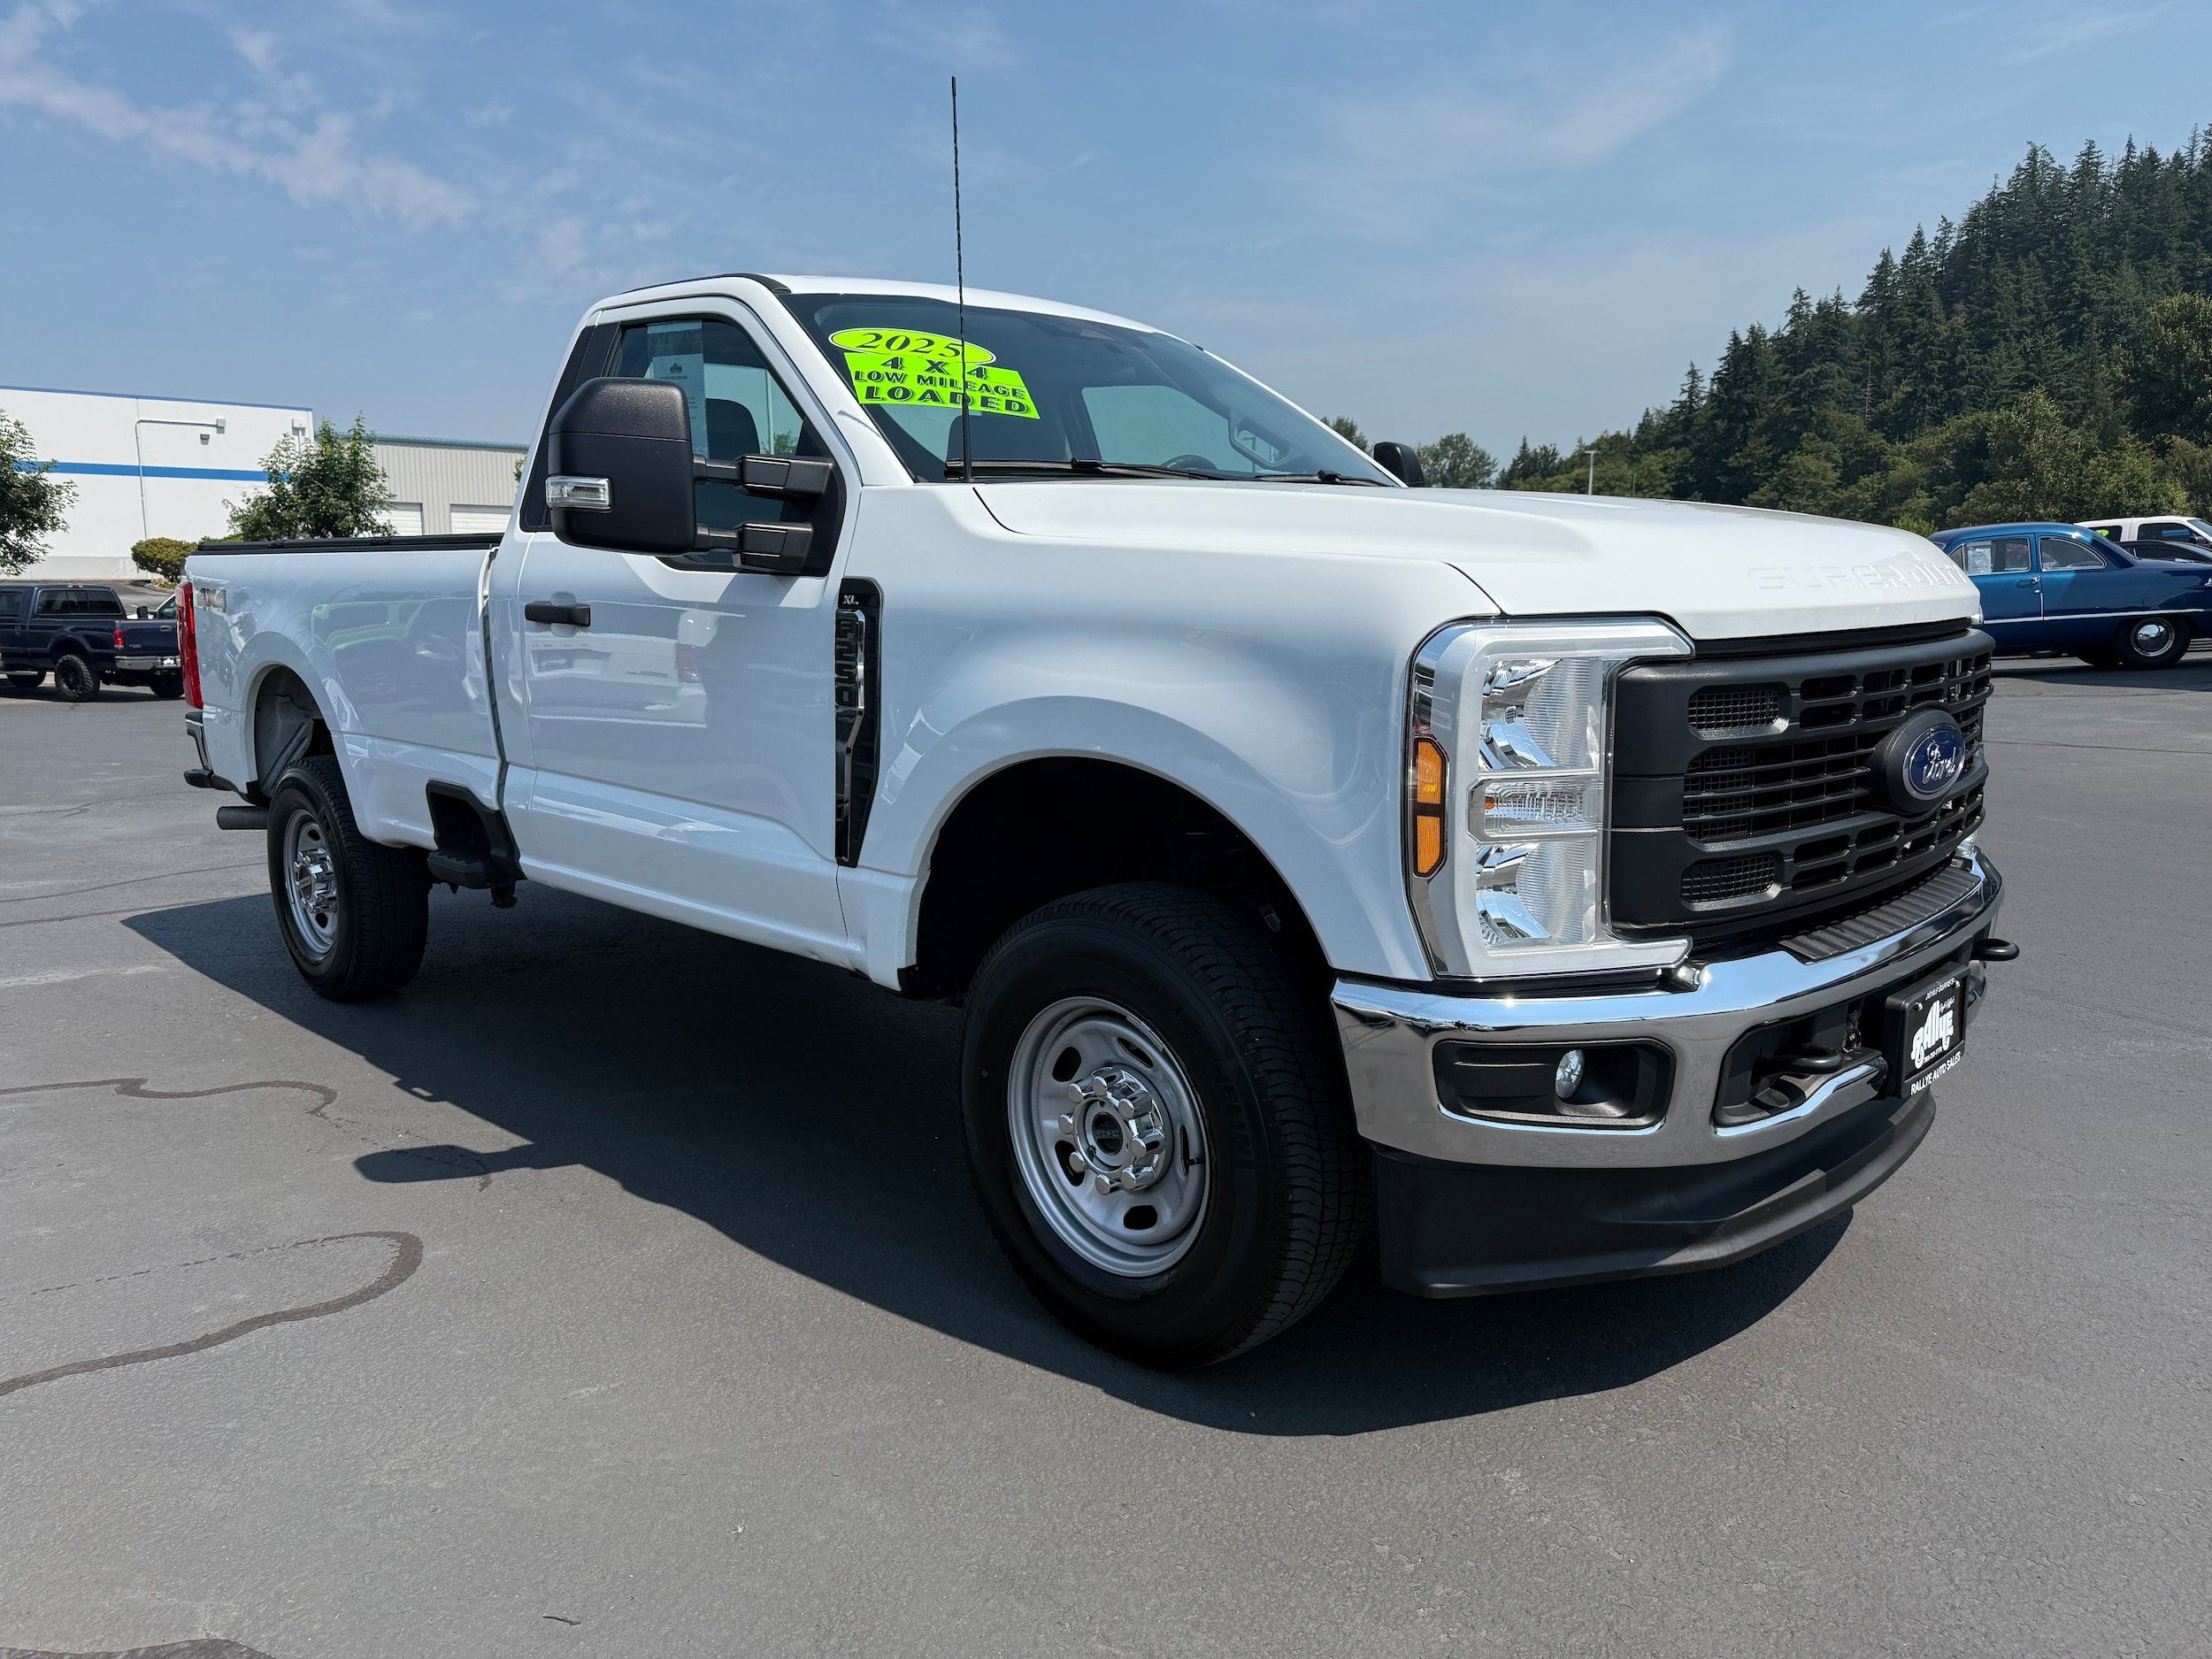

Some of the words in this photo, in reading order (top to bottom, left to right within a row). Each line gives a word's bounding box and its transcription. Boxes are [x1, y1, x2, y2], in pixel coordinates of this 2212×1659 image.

[856, 333, 962, 357] 2025
[880, 356, 904, 371] 4
[925, 359, 950, 375] X
[966, 366, 988, 380] 4
[854, 371, 907, 383] LOW
[917, 374, 1026, 399] MILEAGE
[864, 387, 1029, 413] LOADED
[842, 595, 859, 605] XL
[1922, 740, 1957, 784] Ford
[1910, 1071, 1933, 1096] RALLYE
[1932, 1062, 1947, 1082] AUTO
[1947, 1050, 1961, 1071] SALES
